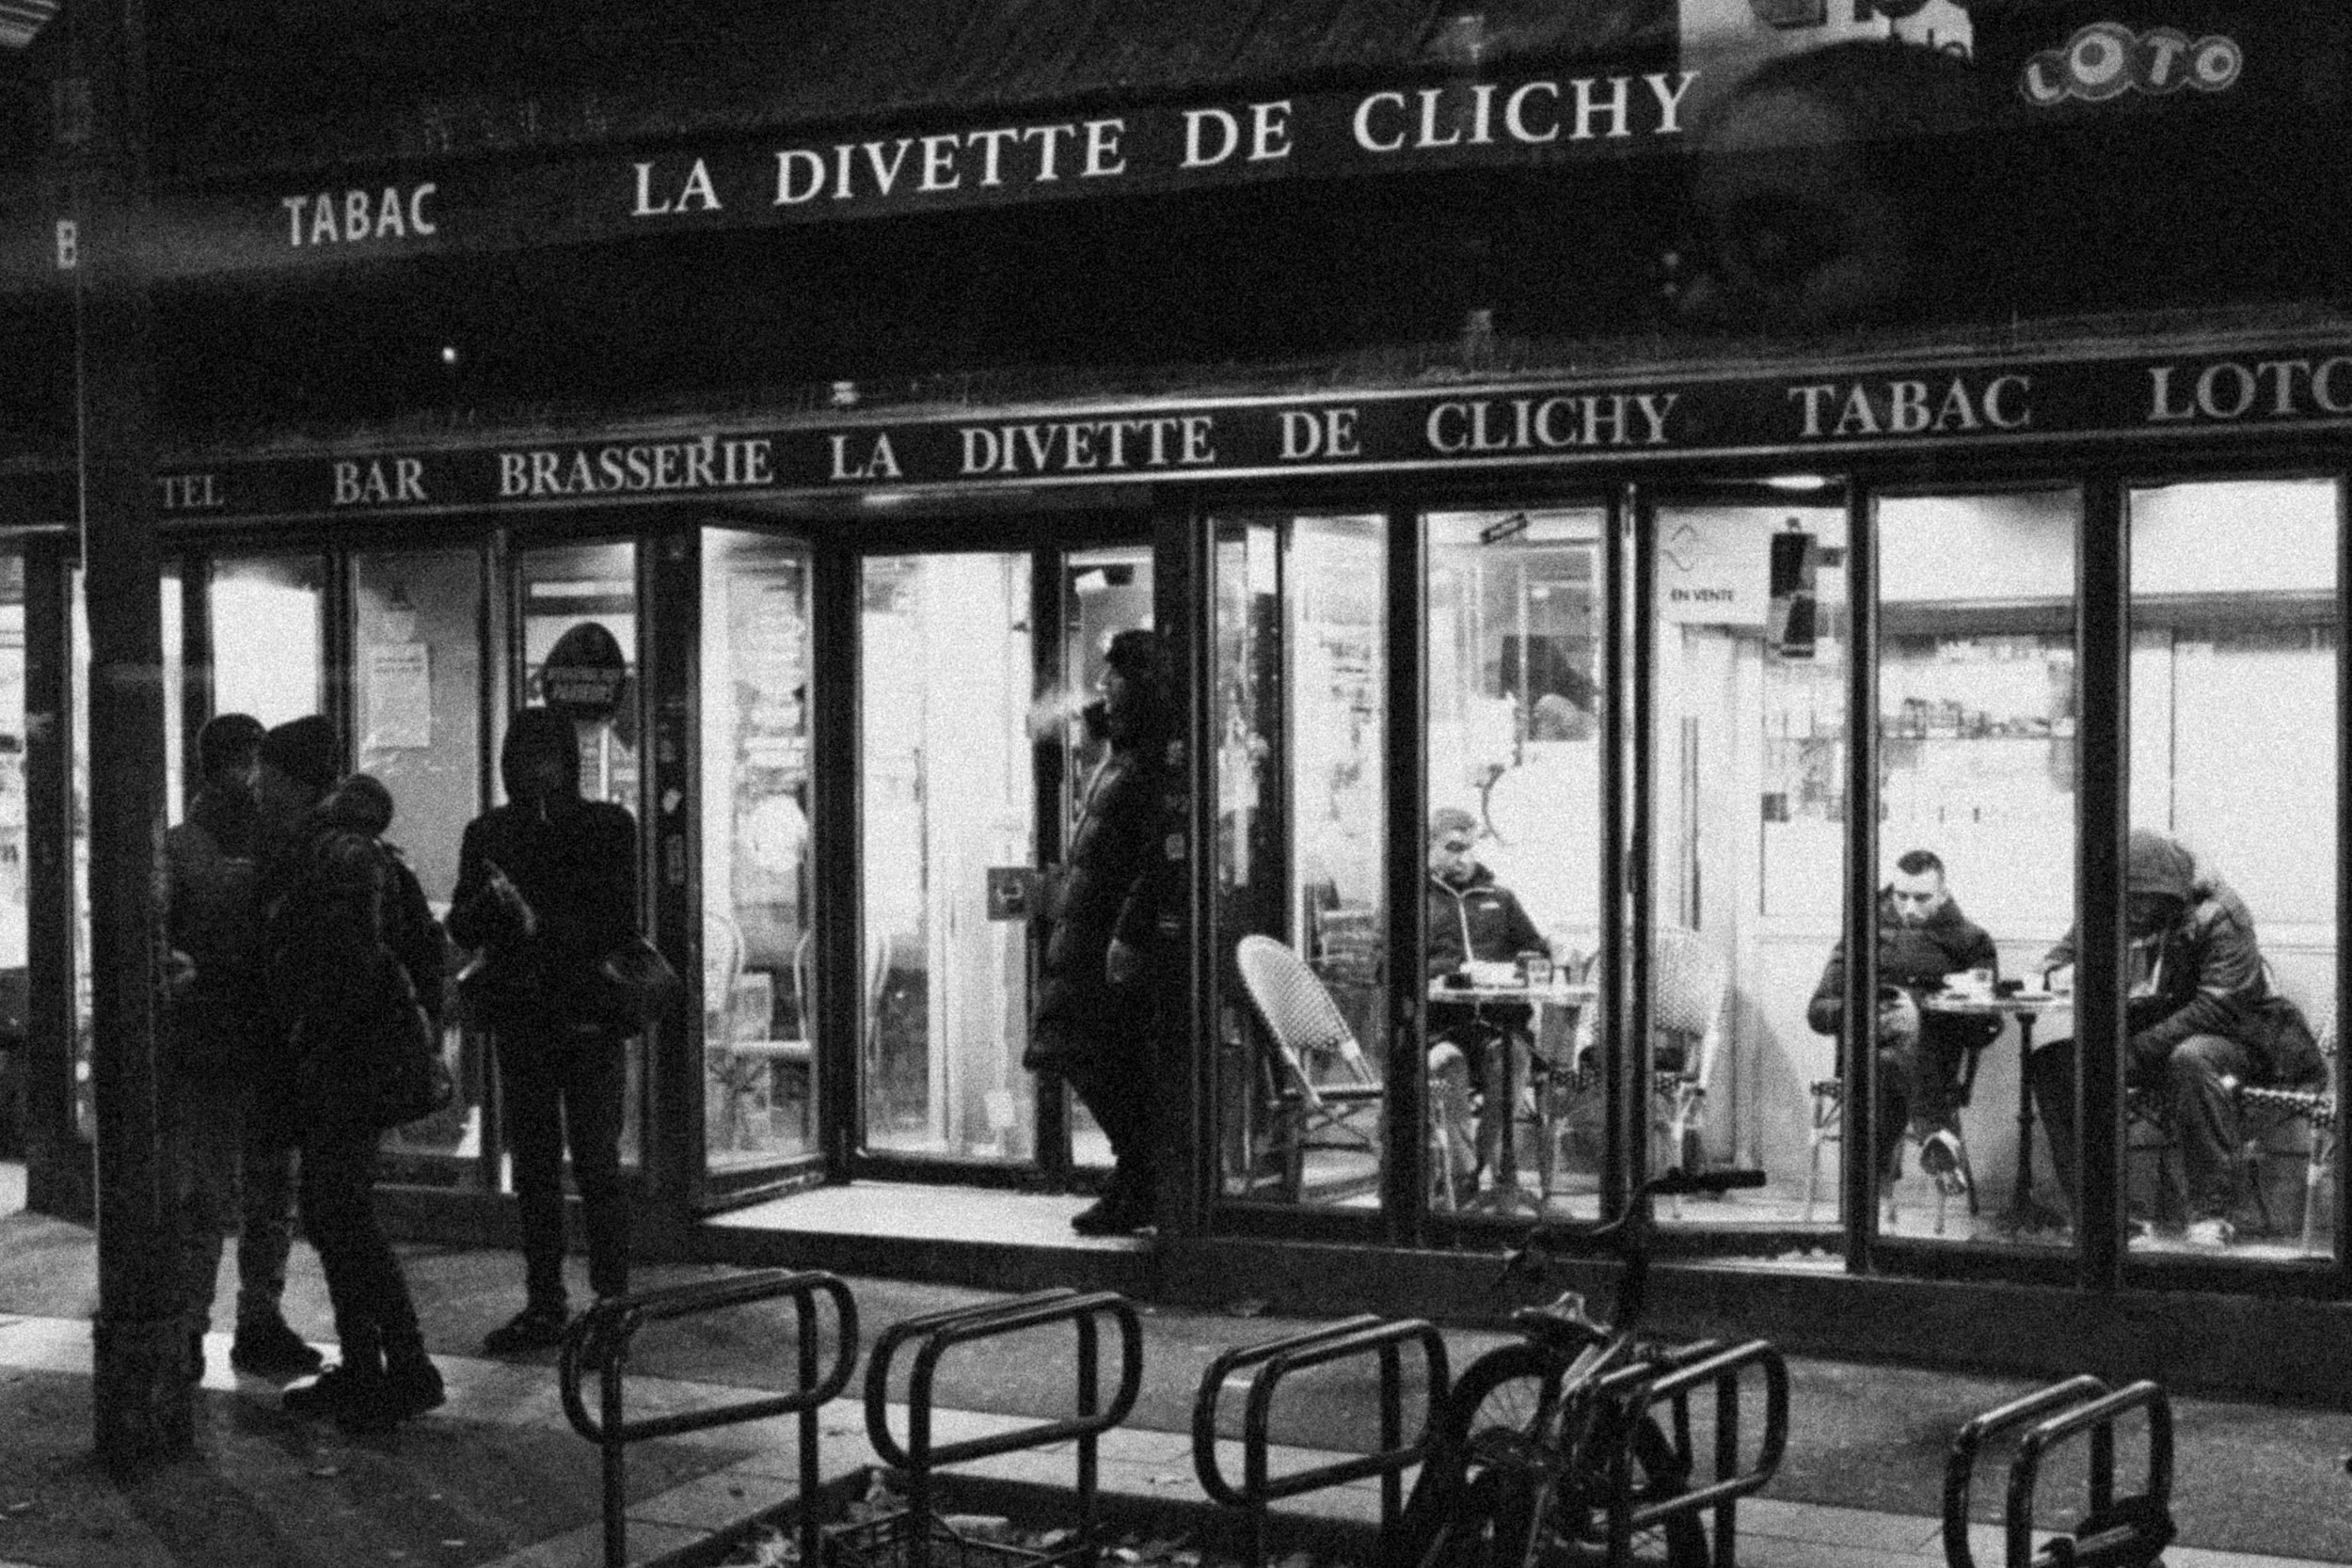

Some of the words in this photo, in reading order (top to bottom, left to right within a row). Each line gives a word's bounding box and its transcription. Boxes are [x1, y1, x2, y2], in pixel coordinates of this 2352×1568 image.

[2027, 31, 2235, 100] LOTO
[631, 157, 723, 216] LA
[773, 118, 1127, 206] DIVETTE
[1181, 100, 1293, 168] DE
[1352, 70, 1702, 152] CLICHY
[282, 182, 437, 247] TABAC
[333, 457, 427, 505] BAR
[499, 438, 773, 499] BRASSERIE
[830, 434, 902, 480] LA
[961, 416, 1216, 474] DIVETTE
[1279, 407, 1360, 460] DE
[1425, 391, 1678, 453] CLICHY
[1788, 375, 2032, 438] TABAC
[1670, 588, 1691, 602] EN
[1692, 588, 1734, 602] VENTE
